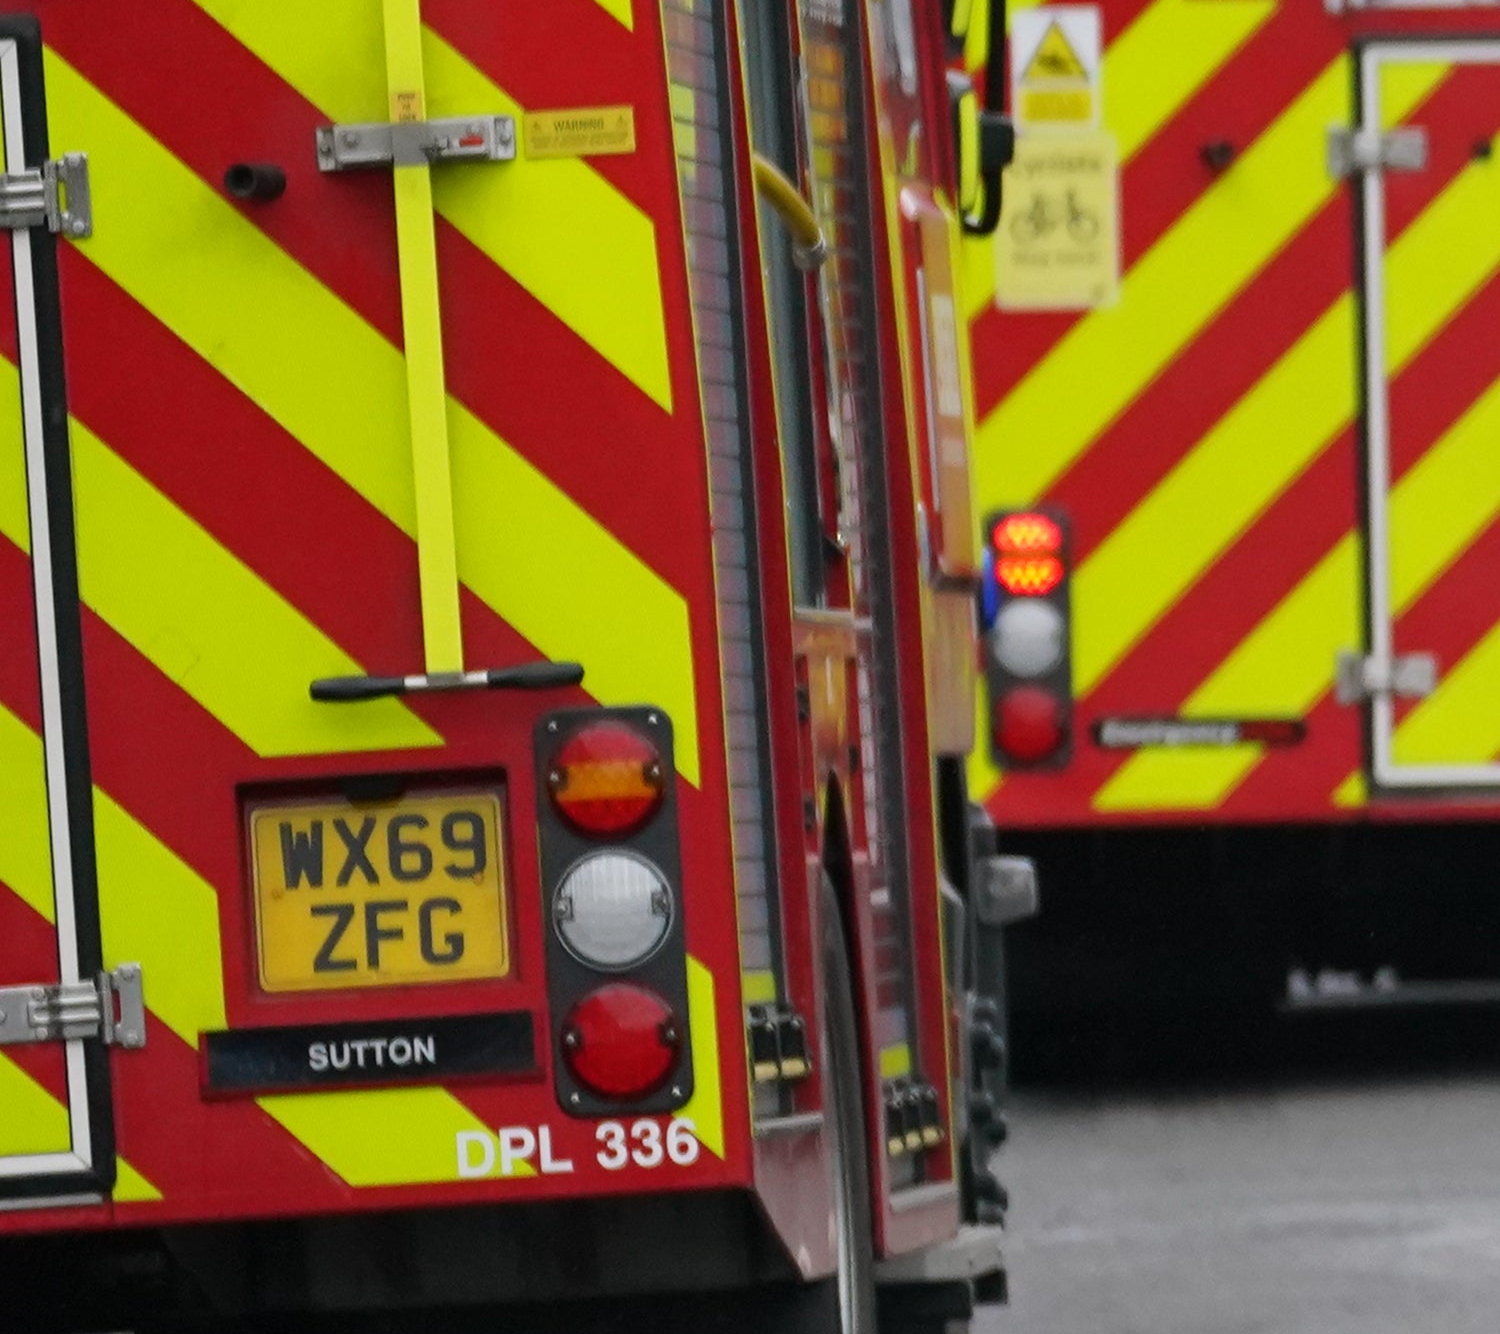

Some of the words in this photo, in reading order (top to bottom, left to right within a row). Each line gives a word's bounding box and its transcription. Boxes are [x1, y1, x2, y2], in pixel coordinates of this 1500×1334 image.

[553, 117, 605, 134] WARNING
[279, 810, 487, 891] WX69
[310, 897, 465, 974] ZFG
[308, 1036, 435, 1071] SUTTON
[456, 1125, 575, 1178] DPL
[595, 1117, 700, 1170] 336
